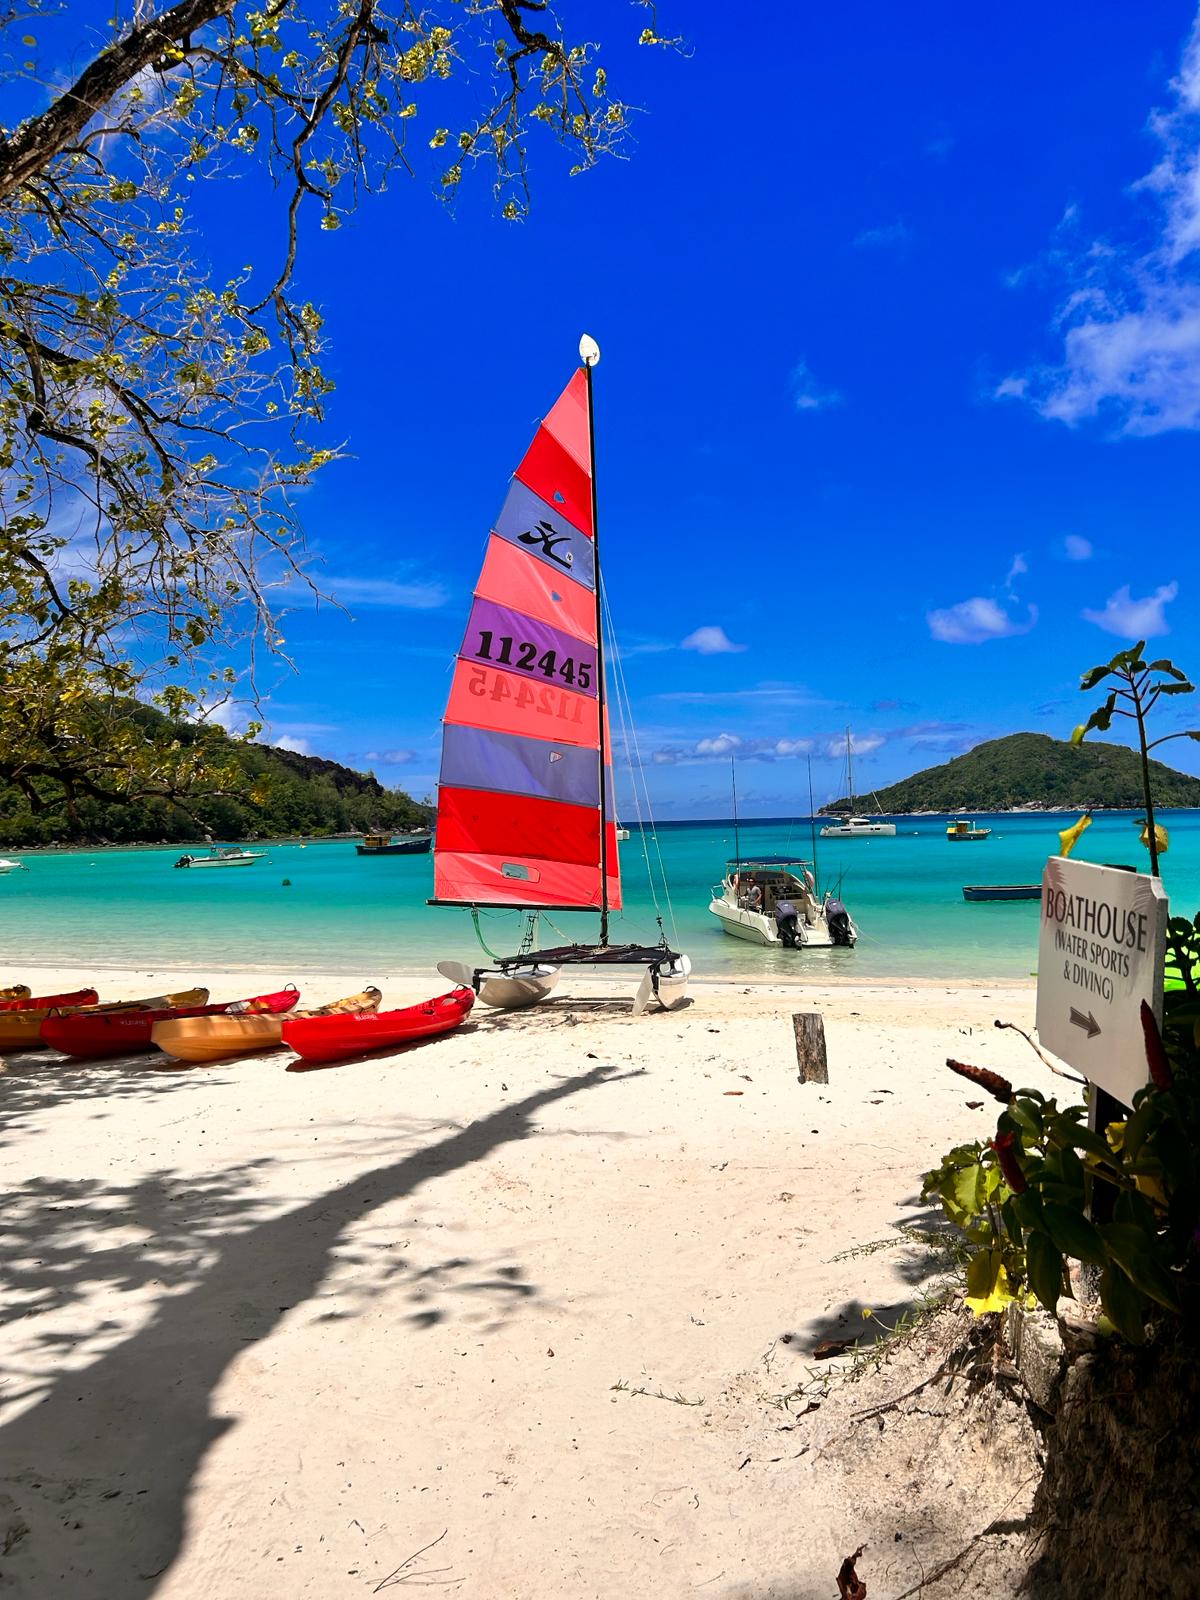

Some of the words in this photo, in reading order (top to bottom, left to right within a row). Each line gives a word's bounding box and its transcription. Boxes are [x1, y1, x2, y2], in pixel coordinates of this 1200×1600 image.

[475, 631, 592, 689] 112445
[1046, 888, 1148, 953] BOATHOUSE
[1055, 928, 1088, 961] (WATER
[1090, 941, 1129, 978] SPORTS
[1063, 960, 1071, 981] &
[1073, 963, 1114, 1004] DIVING)
